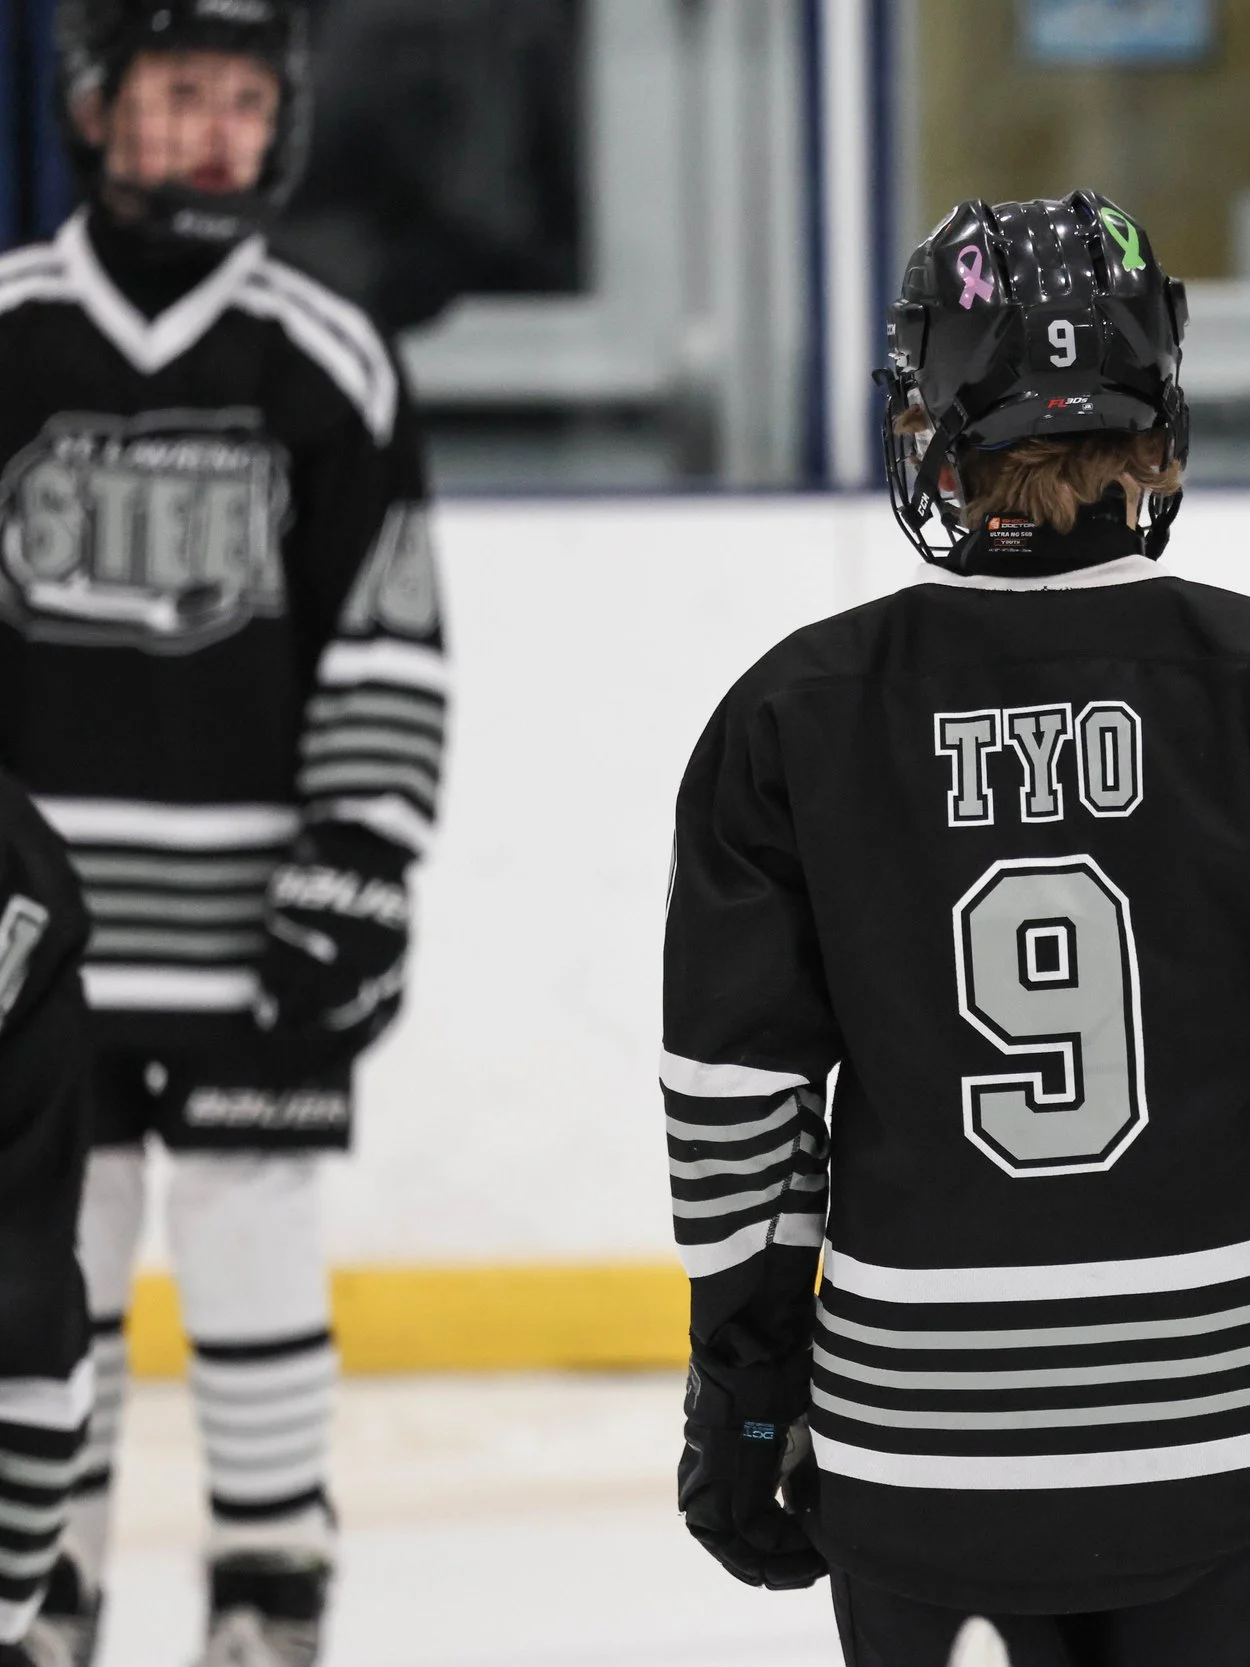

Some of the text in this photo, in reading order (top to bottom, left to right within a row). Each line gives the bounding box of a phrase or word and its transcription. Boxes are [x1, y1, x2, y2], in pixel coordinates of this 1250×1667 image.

[1048, 319, 1077, 368] 9
[917, 492, 930, 517] CCM
[934, 701, 1143, 827] TYO
[952, 854, 1149, 1178] 9
